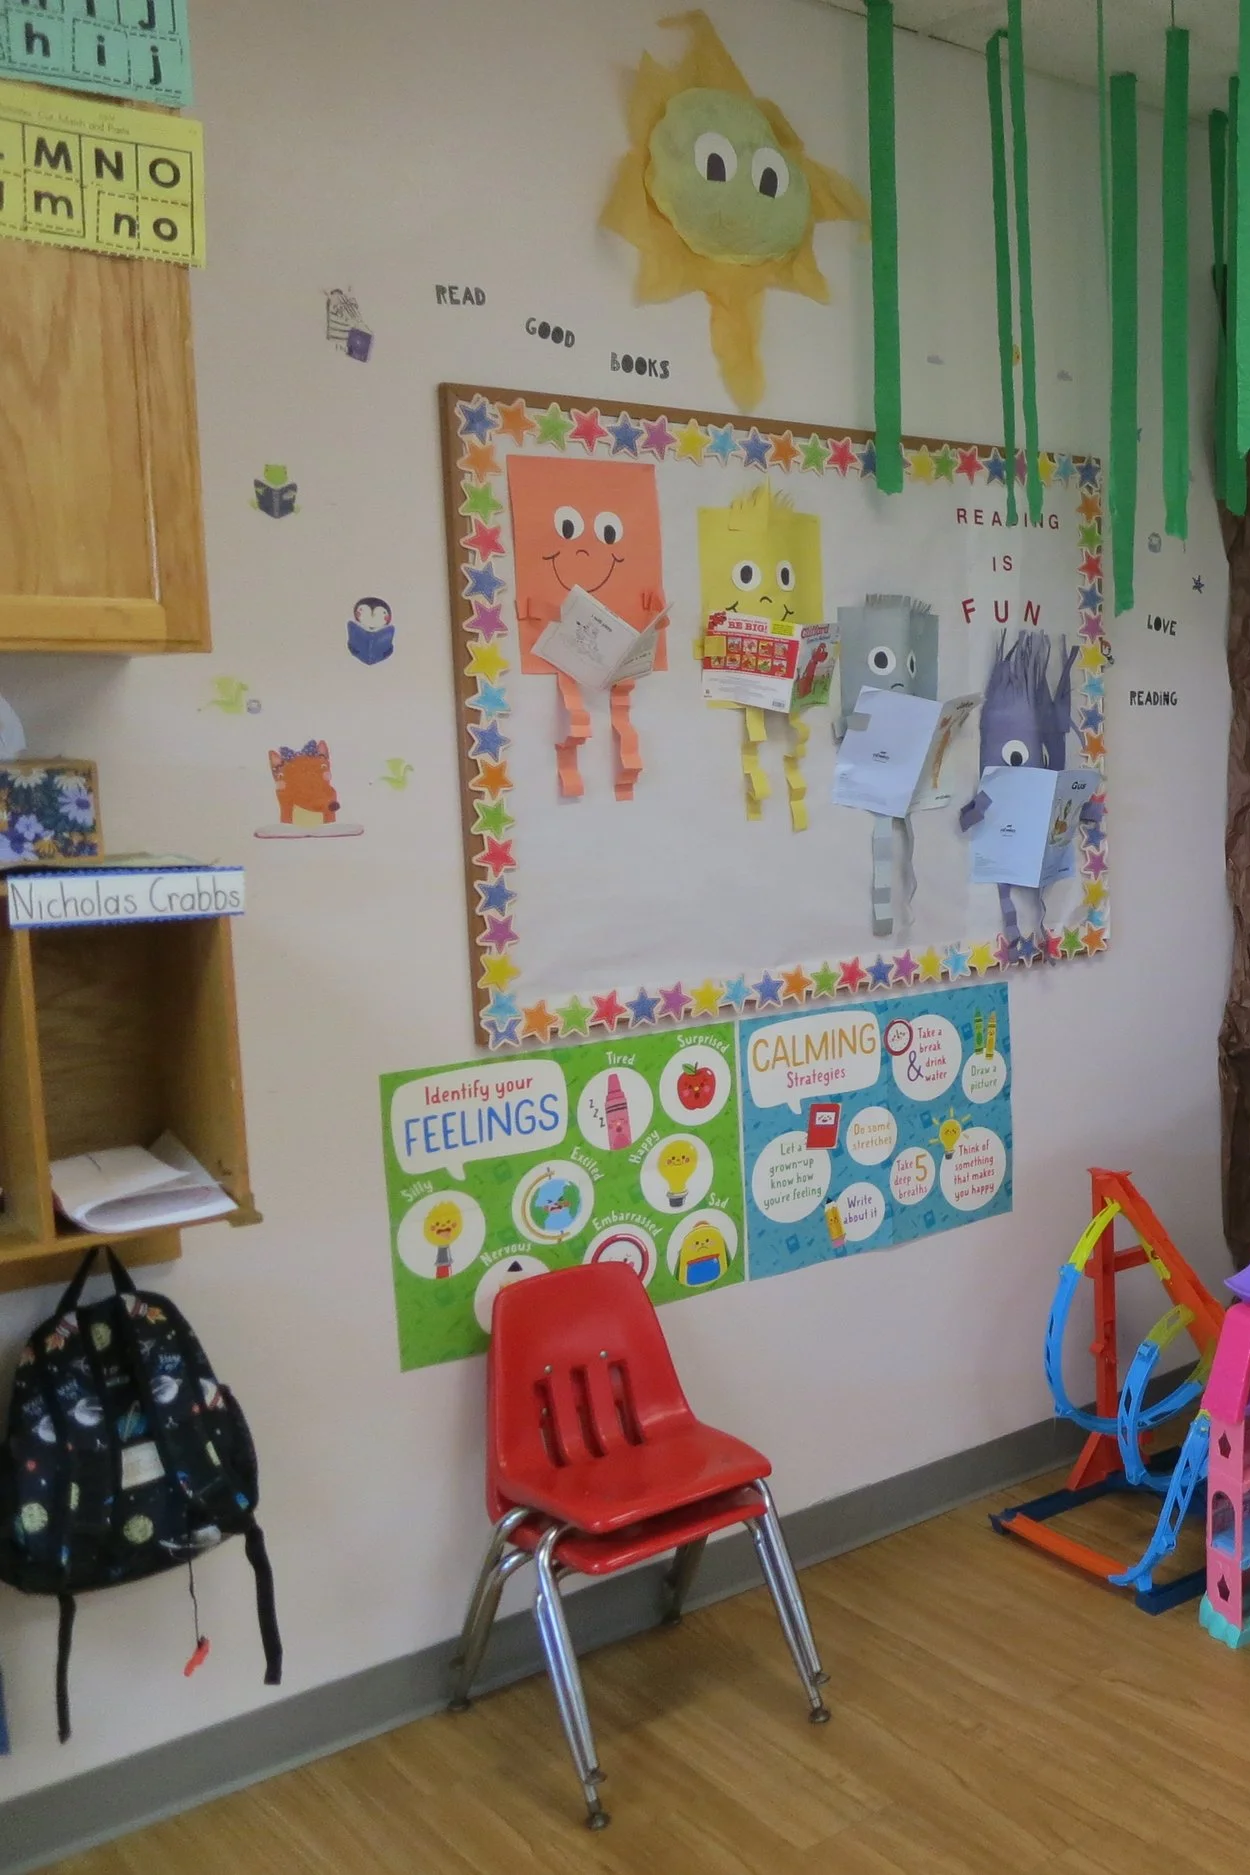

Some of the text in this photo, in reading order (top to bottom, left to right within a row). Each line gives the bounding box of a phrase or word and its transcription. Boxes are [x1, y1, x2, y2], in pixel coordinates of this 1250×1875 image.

[25, 22, 50, 58] h
[97, 34, 106, 67] i
[149, 45, 162, 85] j
[34, 136, 181, 189] M N O
[34, 190, 73, 220] m
[114, 212, 137, 238] n
[152, 217, 178, 242] o
[435, 284, 670, 380] READ GOOD BOOKS
[992, 555, 1013, 571] IS
[961, 599, 1041, 626] FUN
[728, 620, 744, 630] BE
[744, 623, 768, 633] BIG!
[1147, 614, 1177, 636] LOVE
[10, 876, 240, 920] Nicholas Crabbs
[918, 1027, 943, 1039] Take a
[677, 1034, 729, 1054] Surprised
[752, 1023, 876, 1072] CALMING
[919, 1043, 942, 1053] break
[606, 1051, 635, 1066] Tired
[907, 1051, 924, 1082] &
[925, 1057, 946, 1067] drink
[787, 1066, 846, 1089] Strategies
[925, 1070, 947, 1081] water
[971, 1065, 990, 1076] Draw
[425, 1077, 533, 1106] Identify your
[971, 1077, 997, 1093] picture
[405, 1093, 560, 1157] FEELINGS
[854, 1121, 891, 1136] Do some
[629, 1129, 660, 1164] Happy
[781, 1143, 795, 1156] Let
[853, 1135, 892, 1150] stretches
[959, 1141, 989, 1156] Think of
[571, 1146, 604, 1182] Excited
[770, 1158, 814, 1177] grown-up
[896, 1159, 913, 1171] Take
[915, 1154, 927, 1181] 5
[955, 1155, 994, 1172] something
[771, 1173, 813, 1189] know how
[894, 1173, 912, 1186] deep
[954, 1167, 995, 1185] that makes
[400, 1180, 433, 1202] Silly
[793, 1186, 822, 1200] feeling
[899, 1185, 928, 1199] breaths
[955, 1183, 995, 1201] you happy
[709, 1192, 729, 1208] Sad
[847, 1194, 872, 1208] Write
[592, 1210, 663, 1238] Embarrassed
[844, 1208, 878, 1224] about it
[480, 1242, 531, 1266] Nervous
